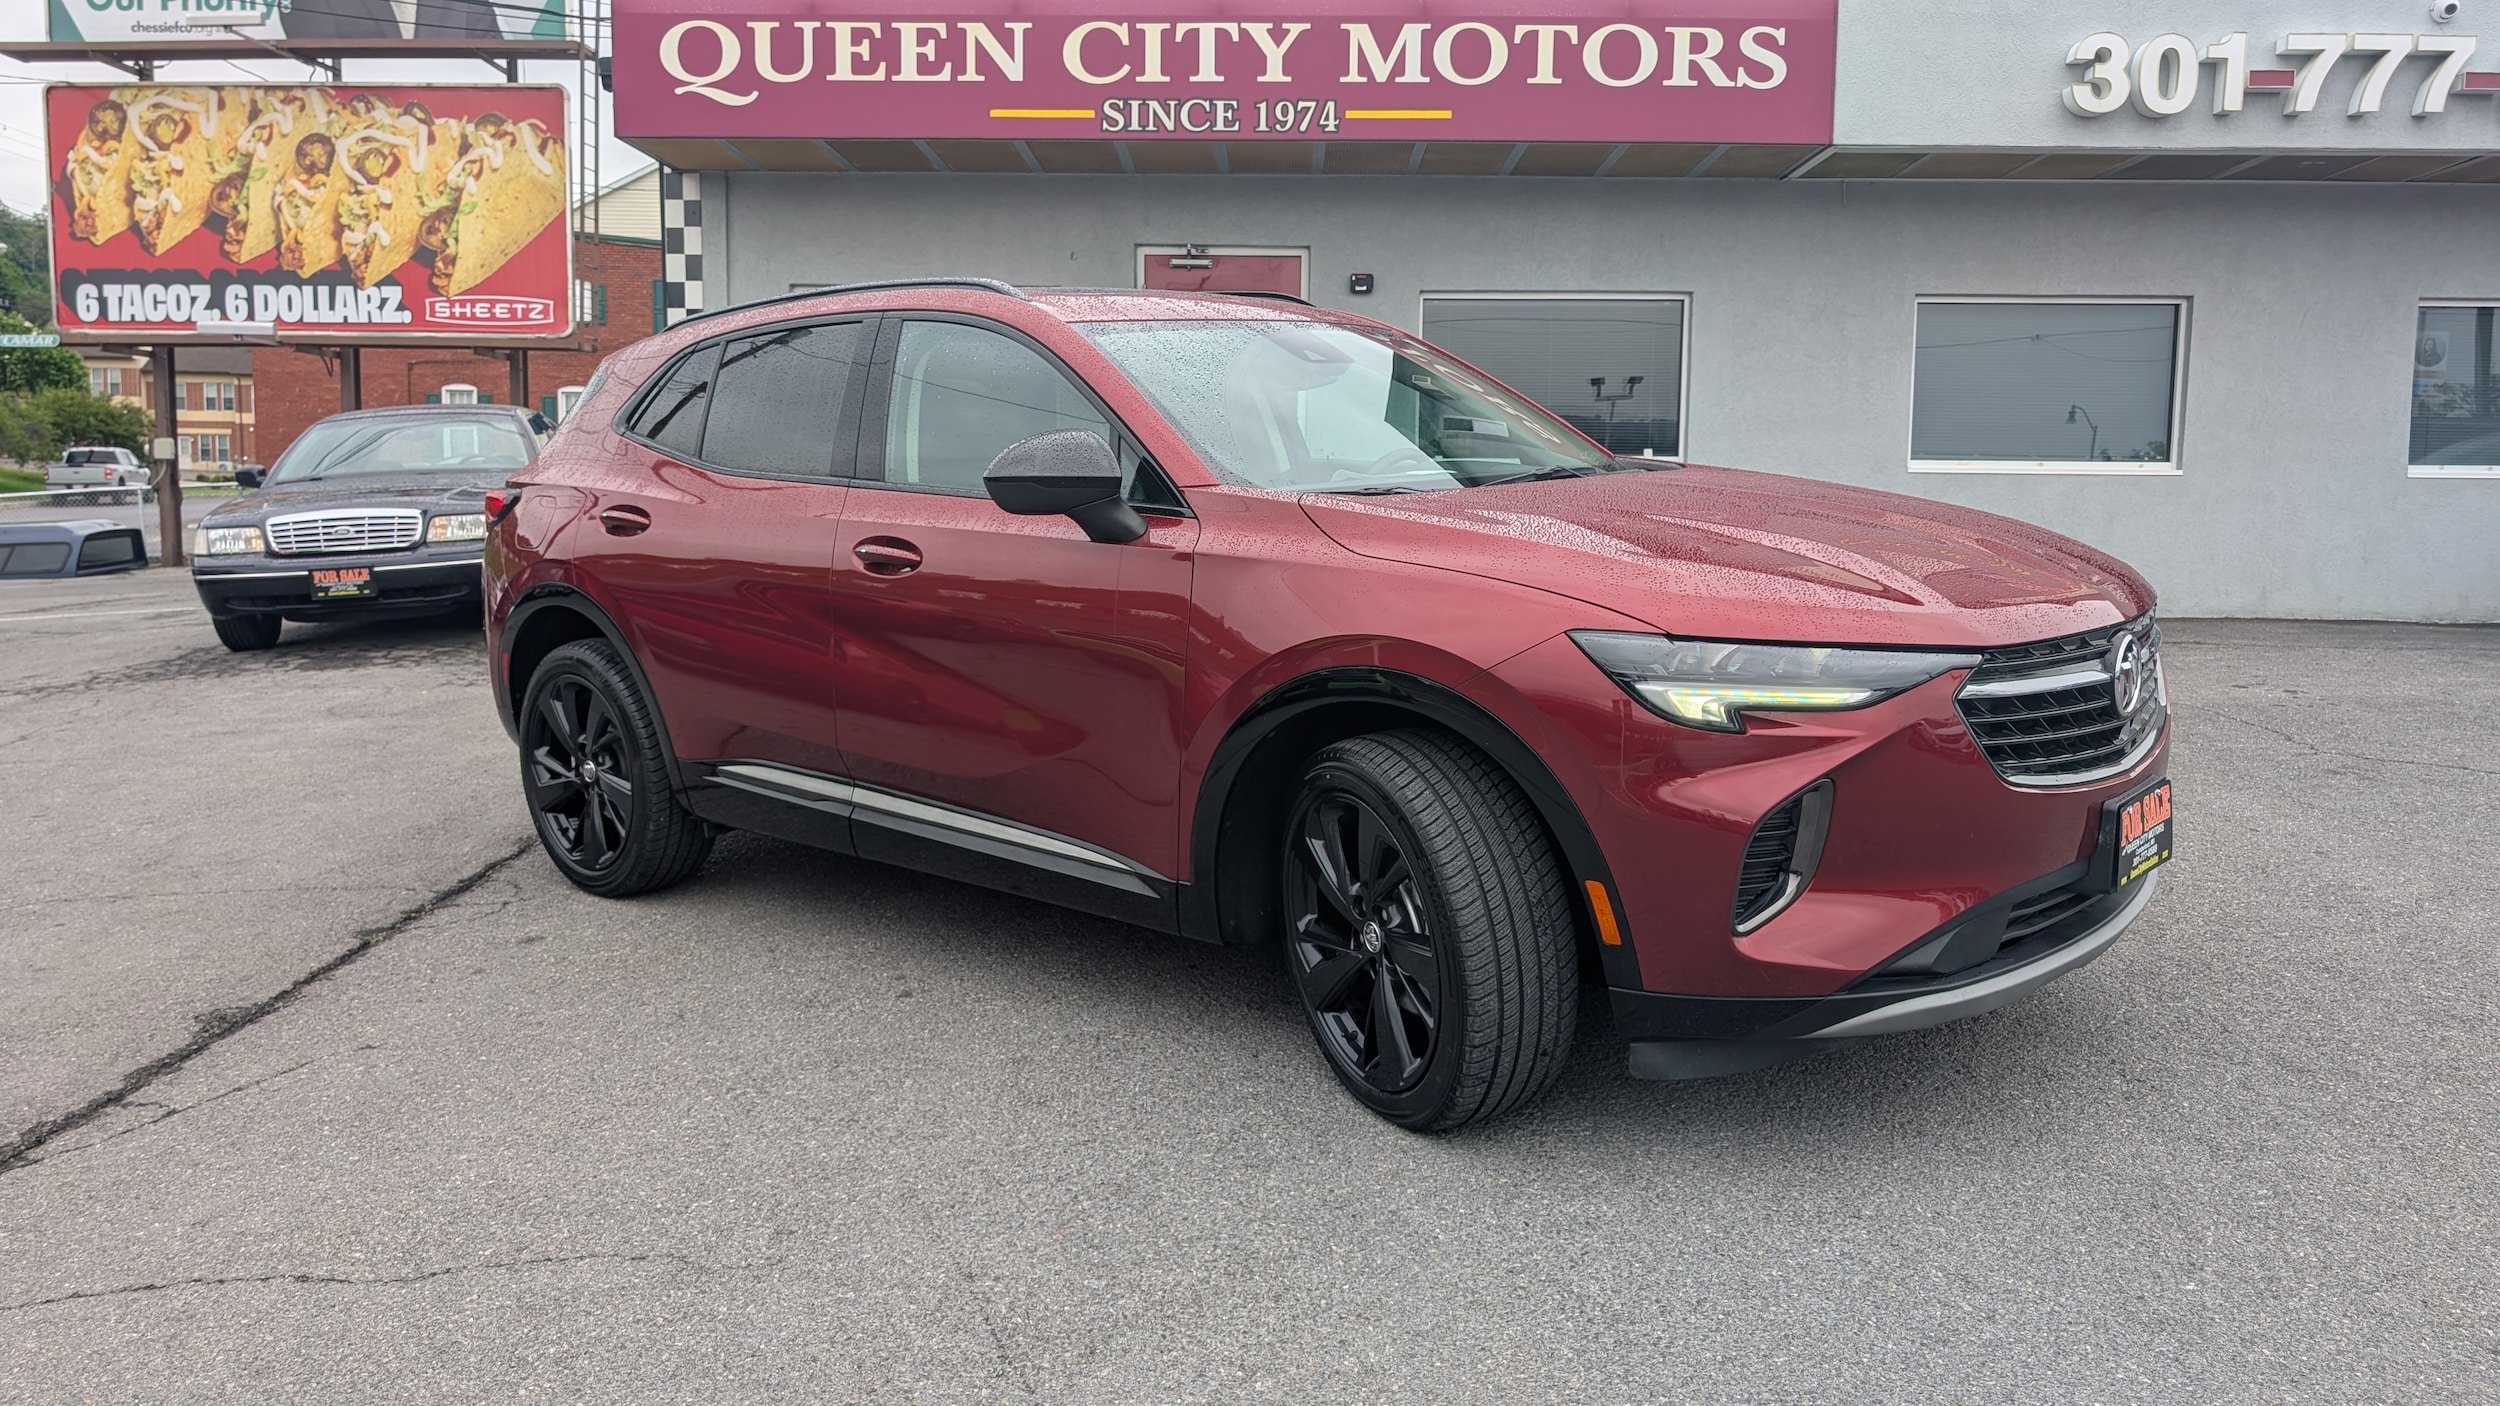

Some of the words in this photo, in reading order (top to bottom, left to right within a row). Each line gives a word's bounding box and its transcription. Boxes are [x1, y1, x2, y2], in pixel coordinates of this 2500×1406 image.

[659, 20, 1033, 106] QUEEN
[1062, 21, 1312, 85] CITY
[1339, 22, 1789, 90] MOTORS
[1101, 98, 1241, 133] SINCE
[1254, 99, 1340, 133] 1974
[76, 284, 99, 322] 6
[225, 284, 249, 322] 6
[253, 285, 413, 323] DOLLARZ.
[434, 302, 545, 319] SHEETZ
[2, 336, 54, 345] LAMAR
[313, 570, 338, 584] FOR
[339, 568, 371, 582] SALE
[2121, 802, 2142, 847] FOR
[2143, 785, 2171, 832] SALE
